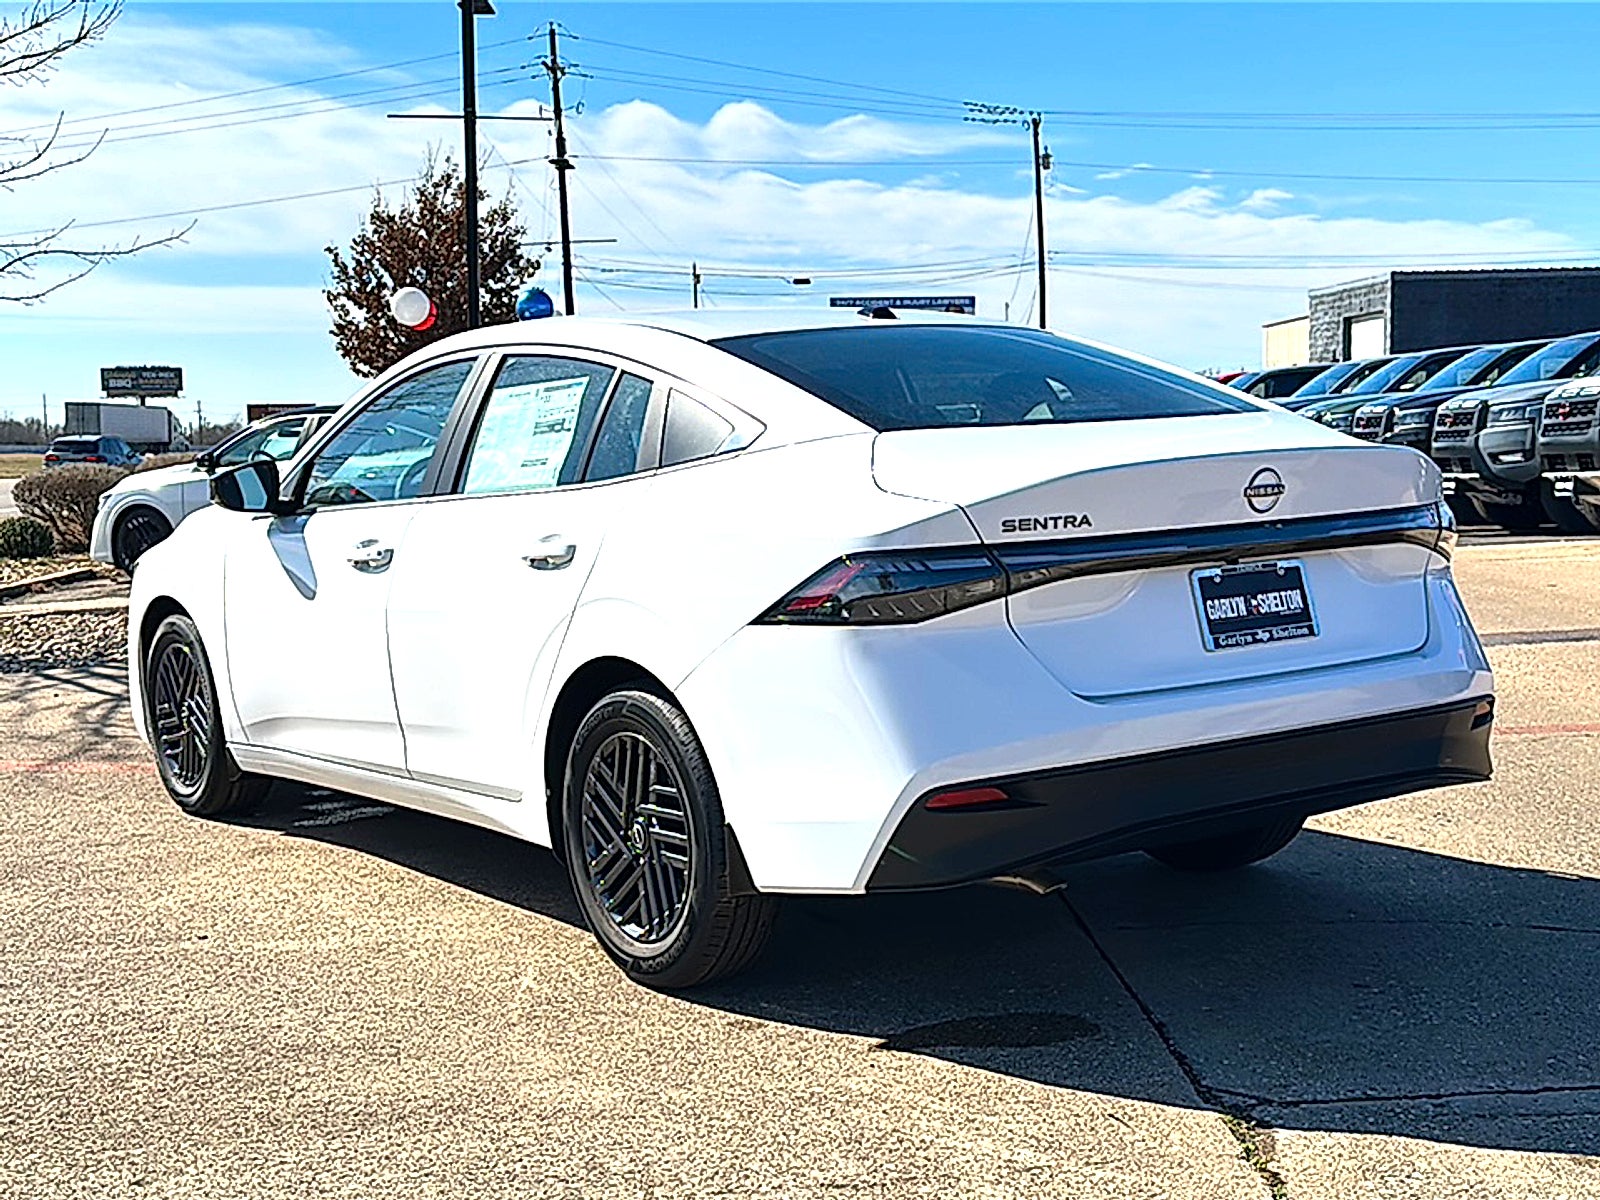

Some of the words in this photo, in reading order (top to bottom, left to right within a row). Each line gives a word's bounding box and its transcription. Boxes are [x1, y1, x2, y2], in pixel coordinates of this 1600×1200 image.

[1001, 514, 1093, 533] SENTRA
[1206, 596, 1248, 620] GARLYN
[1257, 589, 1304, 614] SHELTON
[1219, 634, 1253, 647] Garlyn
[1272, 627, 1310, 639] Shelton
